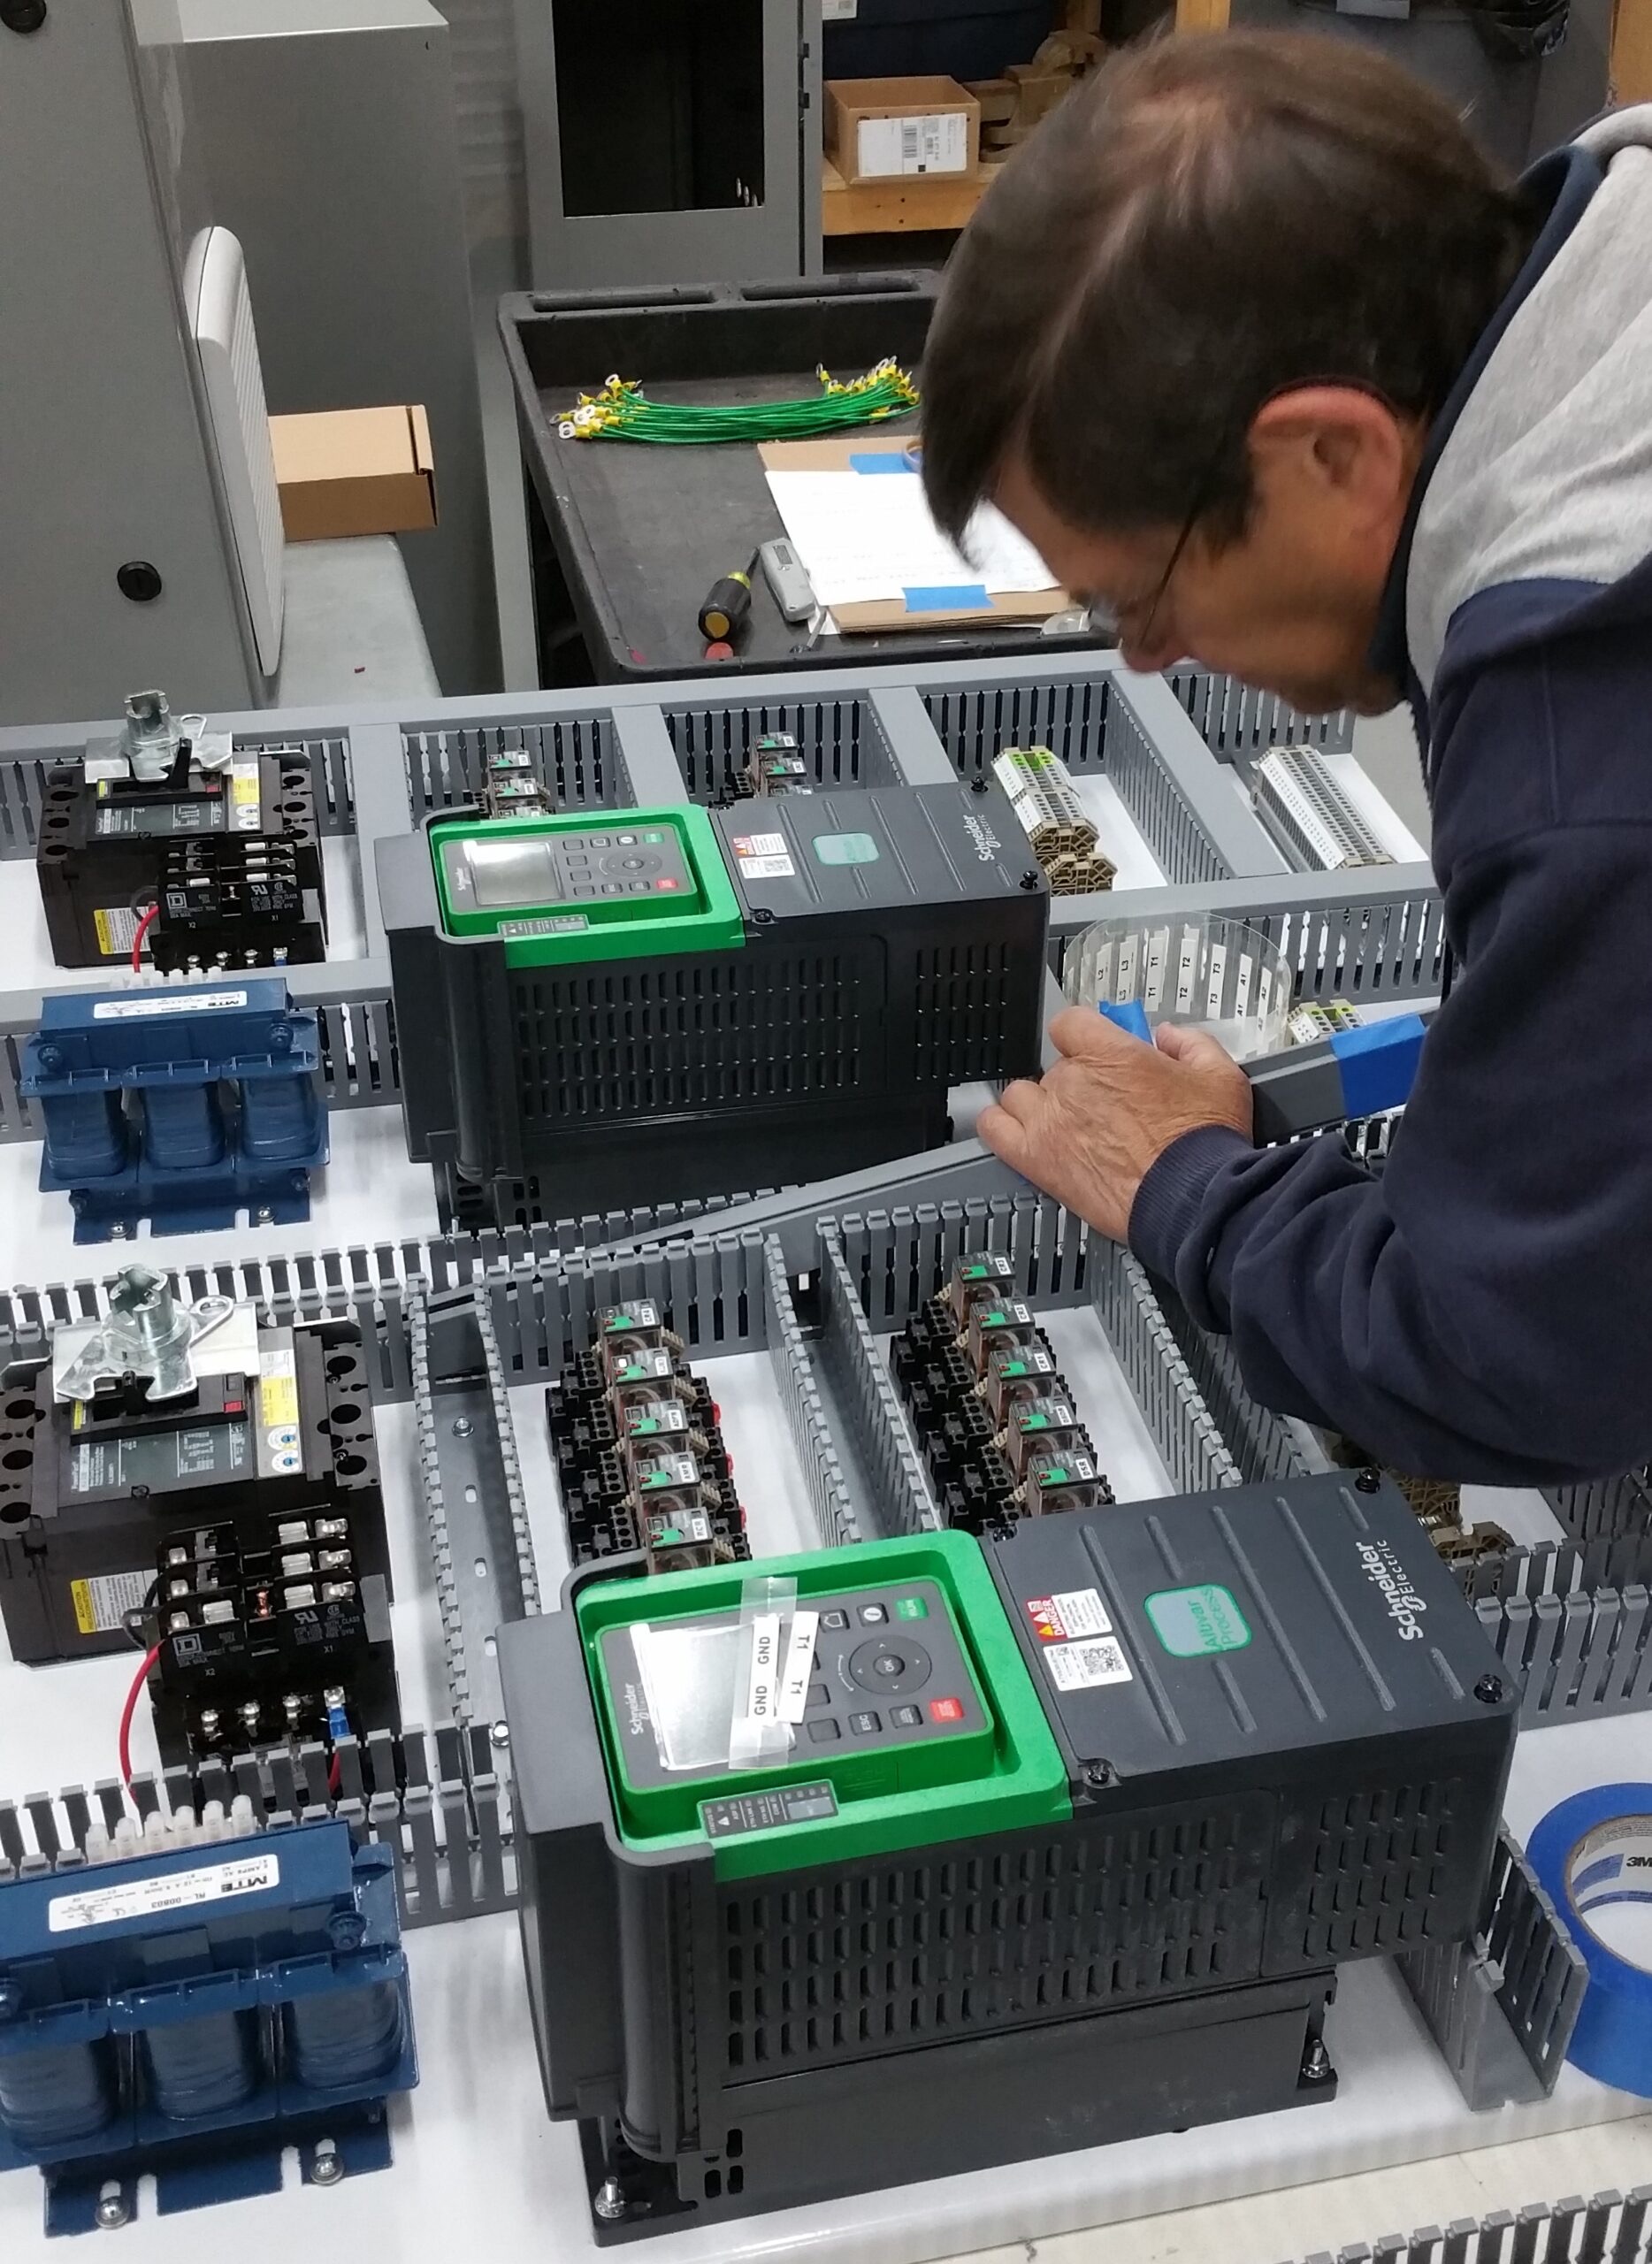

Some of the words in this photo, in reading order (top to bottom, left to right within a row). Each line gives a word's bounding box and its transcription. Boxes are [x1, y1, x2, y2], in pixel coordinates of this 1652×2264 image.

[977, 814, 996, 839] Electric
[962, 815, 995, 860] Schneider
[1120, 960, 1130, 971] L3
[1151, 955, 1159, 967] T1
[1182, 956, 1191, 968] T2
[1212, 962, 1221, 975] T3
[1097, 968, 1105, 981] L2
[1240, 973, 1247, 986] A1
[1149, 986, 1157, 998] T1
[1179, 986, 1189, 998] T2
[1210, 993, 1219, 1005] T3
[1237, 1004, 1244, 1017] A1
[1078, 1459, 1091, 1477] DSR
[1377, 1540, 1413, 1598] Electric
[1354, 1541, 1424, 1641] Schneider
[1044, 1600, 1065, 1637] DANGER
[324, 1644, 334, 1654] X1
[797, 1634, 810, 1650] T1
[759, 1635, 771, 1666] GND
[884, 1658, 895, 1672] OK
[791, 1679, 803, 1695] T1
[753, 1684, 769, 1716] GND
[624, 1682, 644, 1735] Schneider
[860, 1713, 871, 1732] ESC
[1625, 1856, 1652, 1868] 3M
[220, 1875, 268, 1893] MTE
